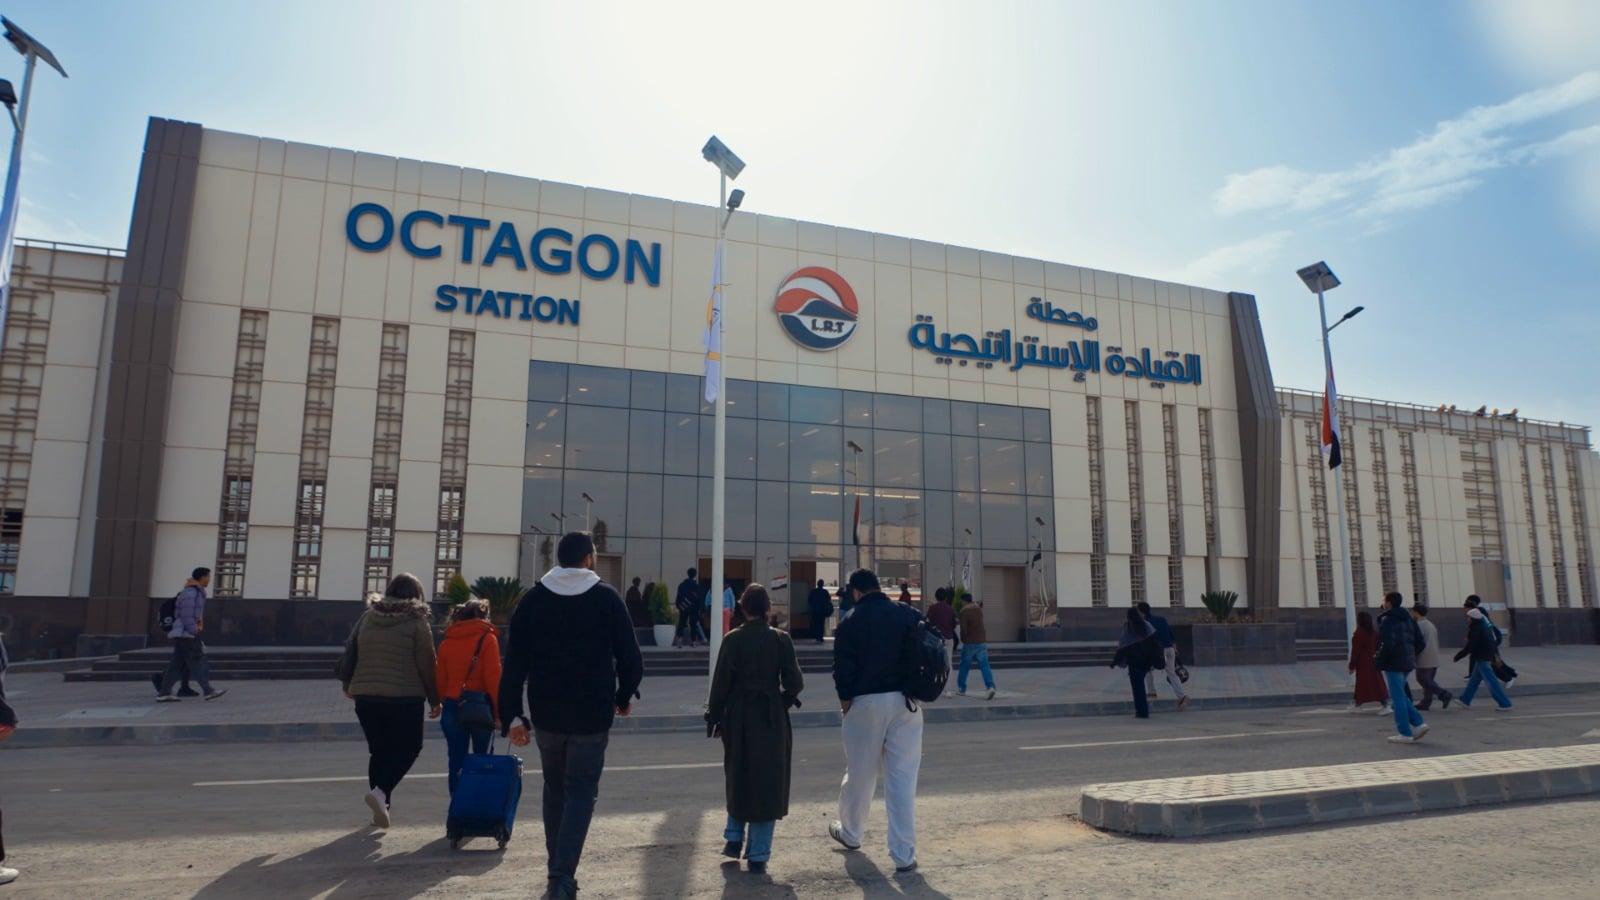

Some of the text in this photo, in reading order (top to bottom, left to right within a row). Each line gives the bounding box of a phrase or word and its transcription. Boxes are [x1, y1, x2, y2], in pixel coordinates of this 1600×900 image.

[345, 202, 662, 287] OCTAGON
[435, 284, 580, 325] STATION
[1026, 297, 1099, 332] محطة
[908, 314, 1203, 388] القيادة الإستراتيجية
